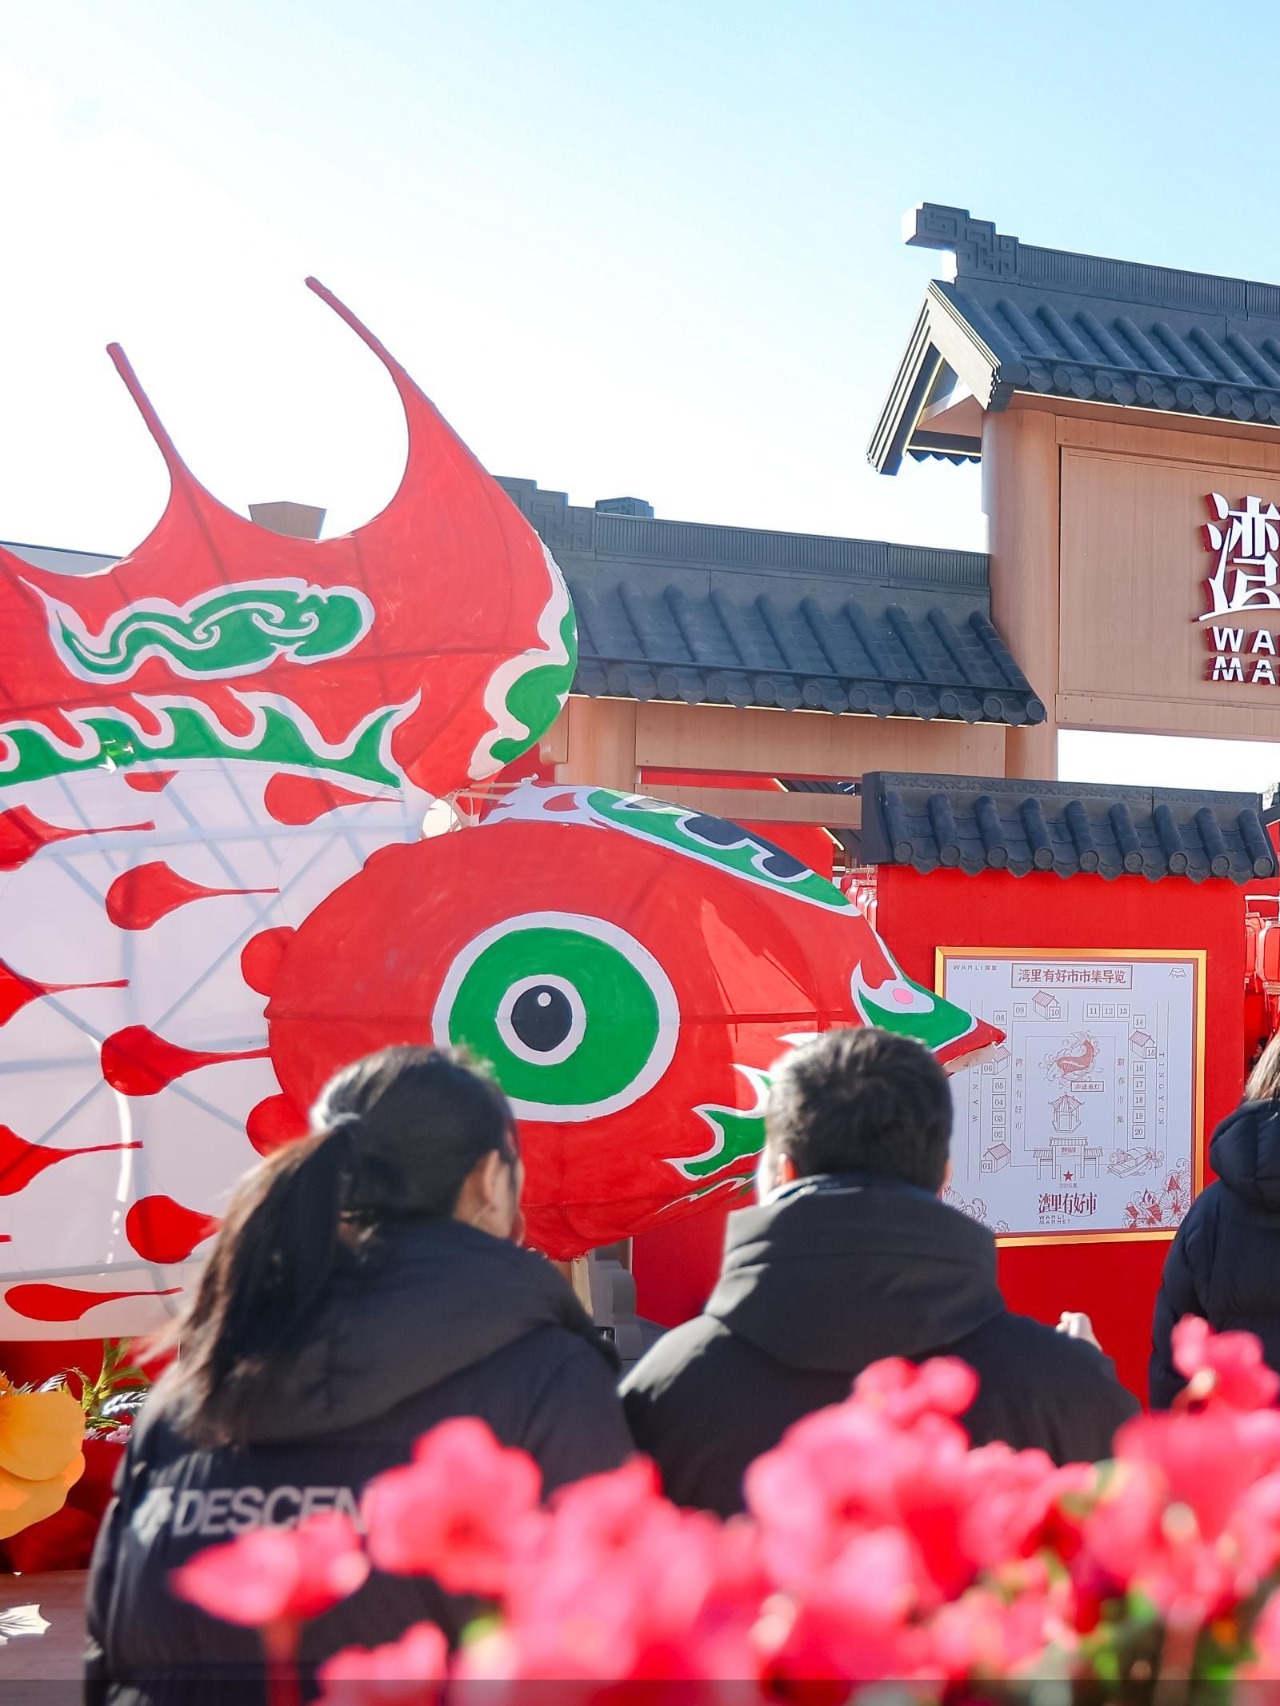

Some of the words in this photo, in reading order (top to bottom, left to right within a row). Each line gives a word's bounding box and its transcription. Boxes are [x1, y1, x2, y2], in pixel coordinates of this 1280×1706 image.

[1018, 968, 1127, 984] 湾里有好市市集导览
[1015, 1006, 1025, 1014] 09
[1050, 1009, 1060, 1017] 10
[1089, 1007, 1098, 1015] 11
[1104, 1007, 1114, 1015] 12
[1119, 1007, 1128, 1015] 13
[1135, 1018, 1144, 1027] 14
[983, 1064, 993, 1072] 06
[994, 1098, 1004, 1106] 04
[1135, 1112, 1144, 1120] 19
[993, 1130, 1003, 1138] 02
[1134, 1128, 1143, 1136] 20
[982, 1162, 992, 1171] 01
[1038, 1192, 1098, 1216] 湾里有好市
